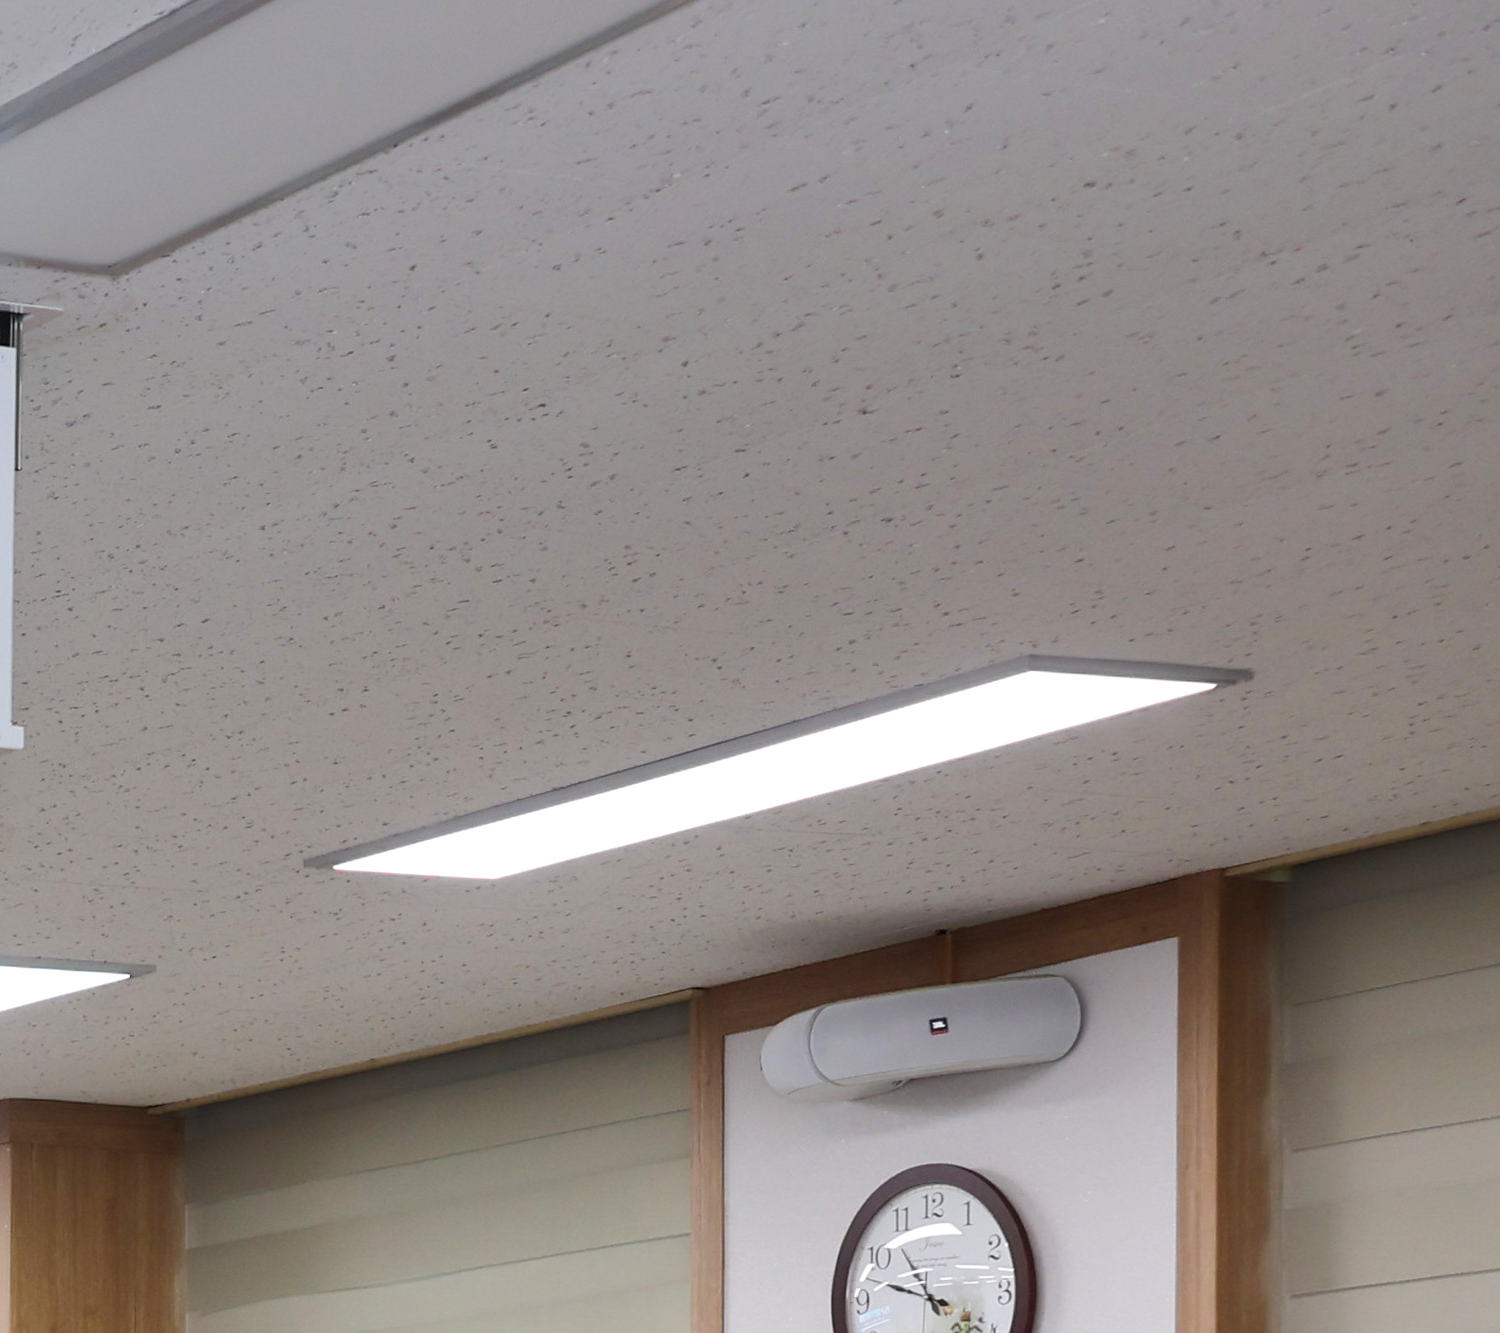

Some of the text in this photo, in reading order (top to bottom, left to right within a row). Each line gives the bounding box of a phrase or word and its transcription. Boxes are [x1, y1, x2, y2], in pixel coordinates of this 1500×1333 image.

[923, 1192, 944, 1219] 12
[964, 1201, 973, 1226] 1
[892, 1207, 910, 1232] 11
[869, 1244, 891, 1270] 10
[988, 1234, 1001, 1260] 2
[856, 1289, 870, 1315] 9
[998, 1280, 1012, 1305] 3
